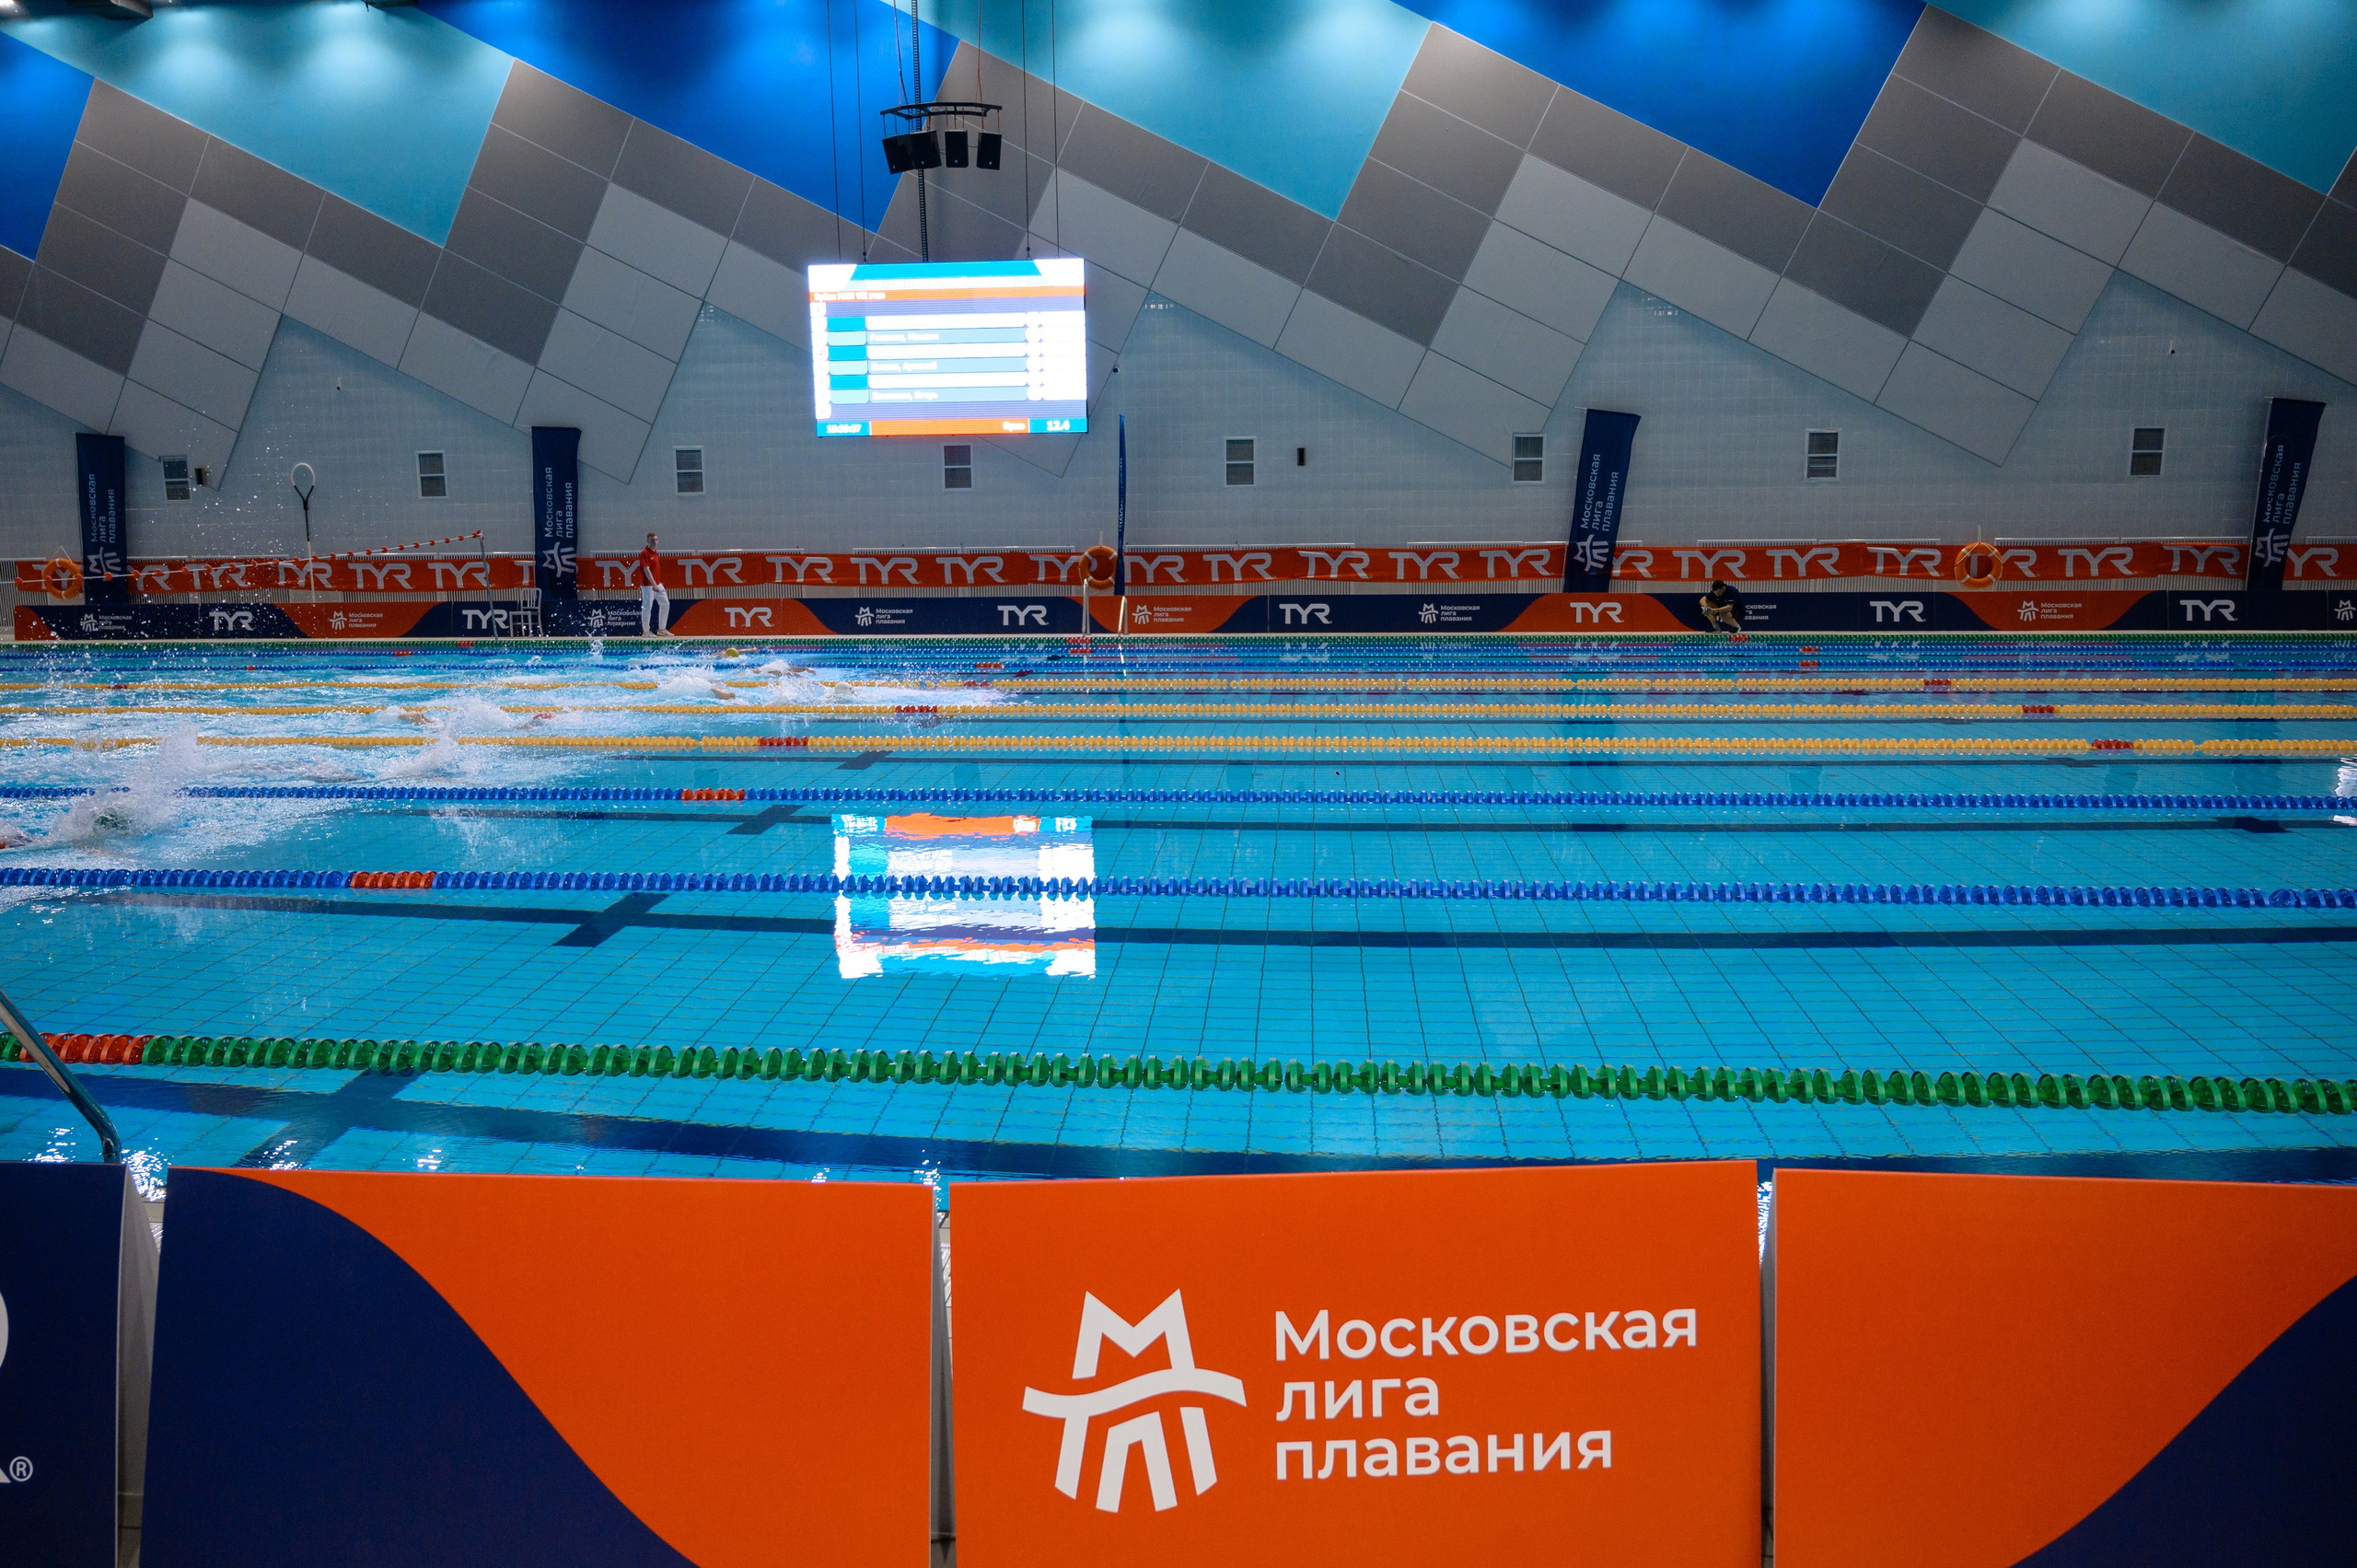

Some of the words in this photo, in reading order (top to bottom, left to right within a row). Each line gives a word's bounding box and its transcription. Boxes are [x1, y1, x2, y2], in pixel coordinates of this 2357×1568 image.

[1580, 454, 1601, 529] Московская
[2262, 445, 2285, 523] Московская
[2282, 462, 2302, 525] плавания
[88, 473, 98, 543] Московская
[545, 467, 554, 538] Московская
[564, 482, 574, 539] плавания
[1591, 500, 1604, 530] лига
[1601, 471, 1620, 531] плавания
[2272, 493, 2285, 524] лига
[99, 516, 107, 543] лига
[108, 489, 116, 543] плавания
[595, 560, 641, 587] TY
[678, 557, 744, 585] TYR
[765, 555, 834, 584] TYR
[849, 556, 921, 585] TYR
[935, 555, 1005, 584] TYR
[1202, 552, 1275, 581] TYR
[1297, 551, 1370, 579] TYR
[1387, 551, 1460, 580] TYR
[1479, 548, 1551, 577] TYR
[1611, 549, 1654, 578] YR
[1672, 549, 1747, 578] TYR
[1766, 546, 1840, 577] TYR
[1866, 546, 1942, 577] TYR
[2057, 546, 2135, 577] TYR
[2162, 545, 2241, 575] TYR
[2286, 547, 2339, 577] YR
[185, 562, 249, 590] TYR
[277, 562, 333, 588] TYR
[347, 562, 414, 589] TYR
[427, 561, 493, 589] TYR
[208, 610, 254, 632] TYR
[461, 609, 509, 630] TYR
[724, 606, 773, 628] TYR
[997, 604, 1048, 626] TYR
[1279, 603, 1331, 624] TYR
[1569, 600, 1623, 623] TYR
[1869, 599, 1925, 622] TYR
[2179, 599, 2236, 621] TYR
[1274, 1307, 1698, 1362] Московская
[1274, 1375, 1440, 1422] лига
[1274, 1428, 1613, 1481] плавания
